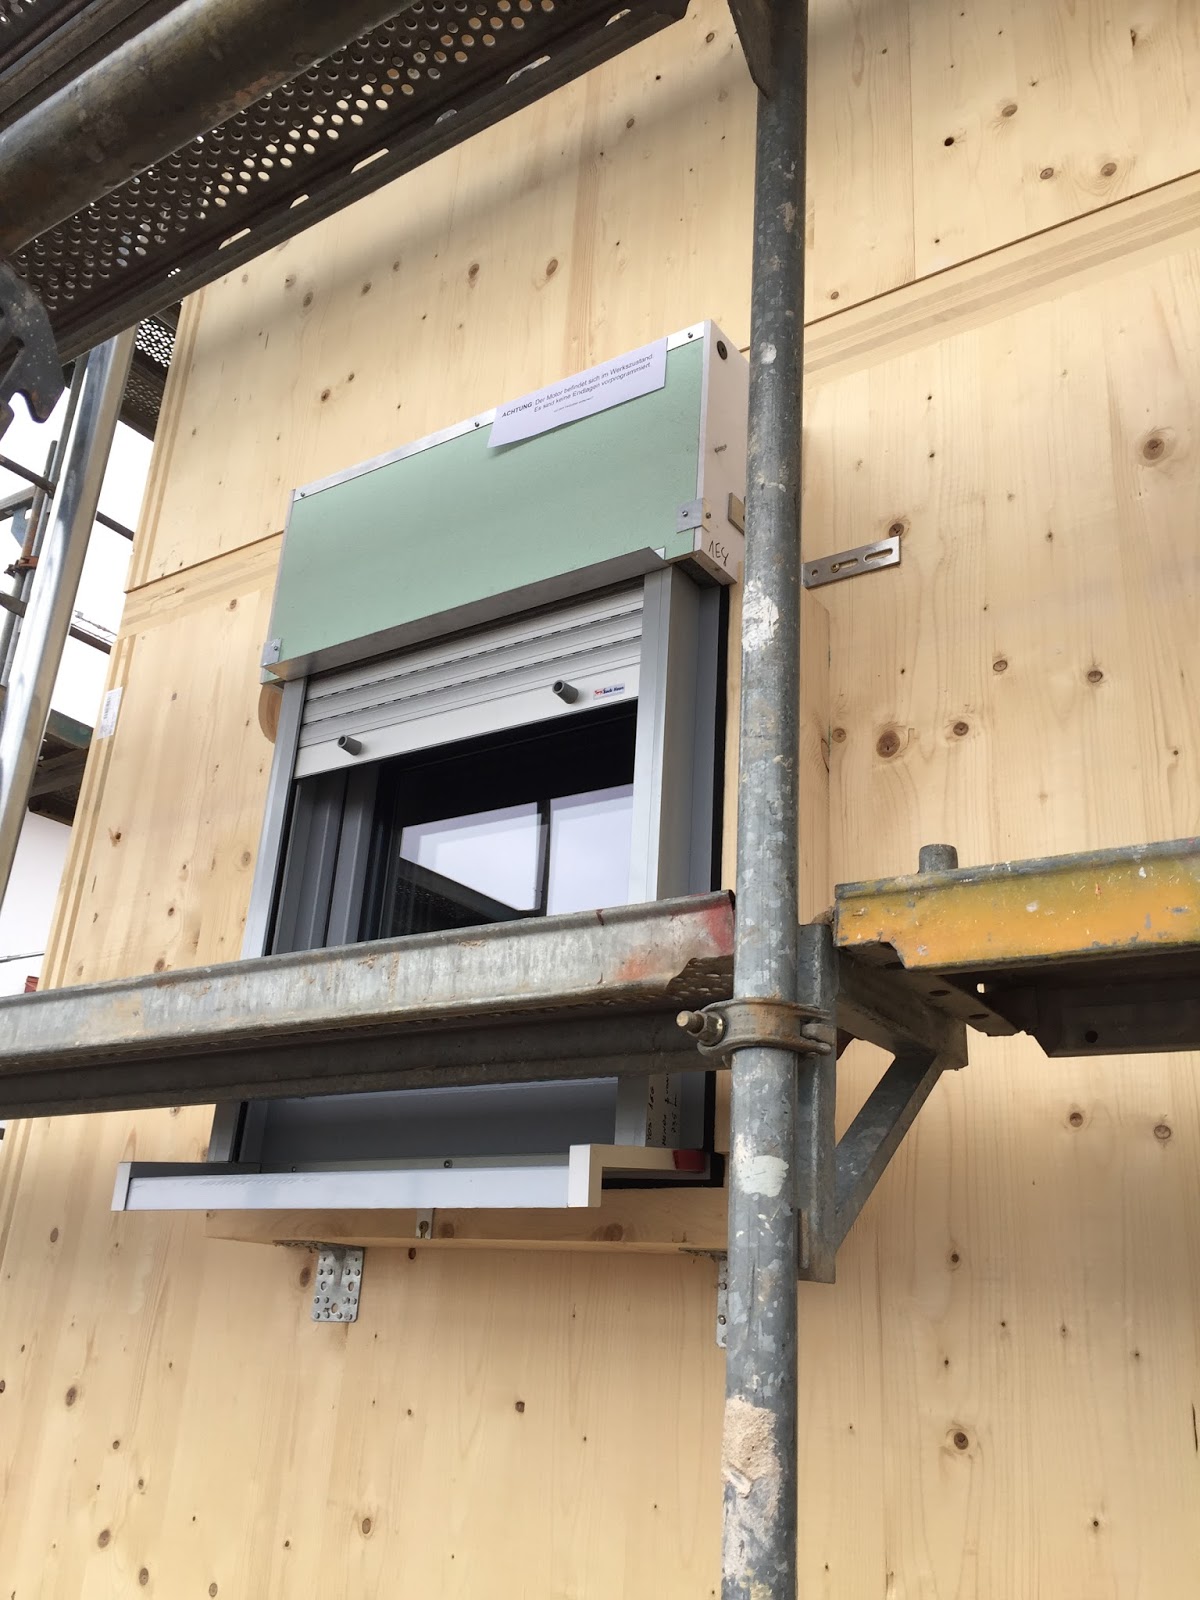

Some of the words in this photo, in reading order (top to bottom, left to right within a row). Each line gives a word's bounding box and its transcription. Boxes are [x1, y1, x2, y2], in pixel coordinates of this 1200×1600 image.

[502, 401, 532, 418] ACHTUNG
[535, 397, 546, 406] Der
[547, 390, 563, 401] Motor
[564, 380, 588, 394] befindet
[588, 375, 600, 385] sich
[601, 372, 609, 380] im
[610, 353, 653, 375] Werkszustand
[534, 404, 542, 413] Es
[543, 400, 555, 410] sind
[556, 394, 571, 405] keine
[572, 382, 600, 399] Endlagen
[601, 362, 651, 387] vorprogrammiert
